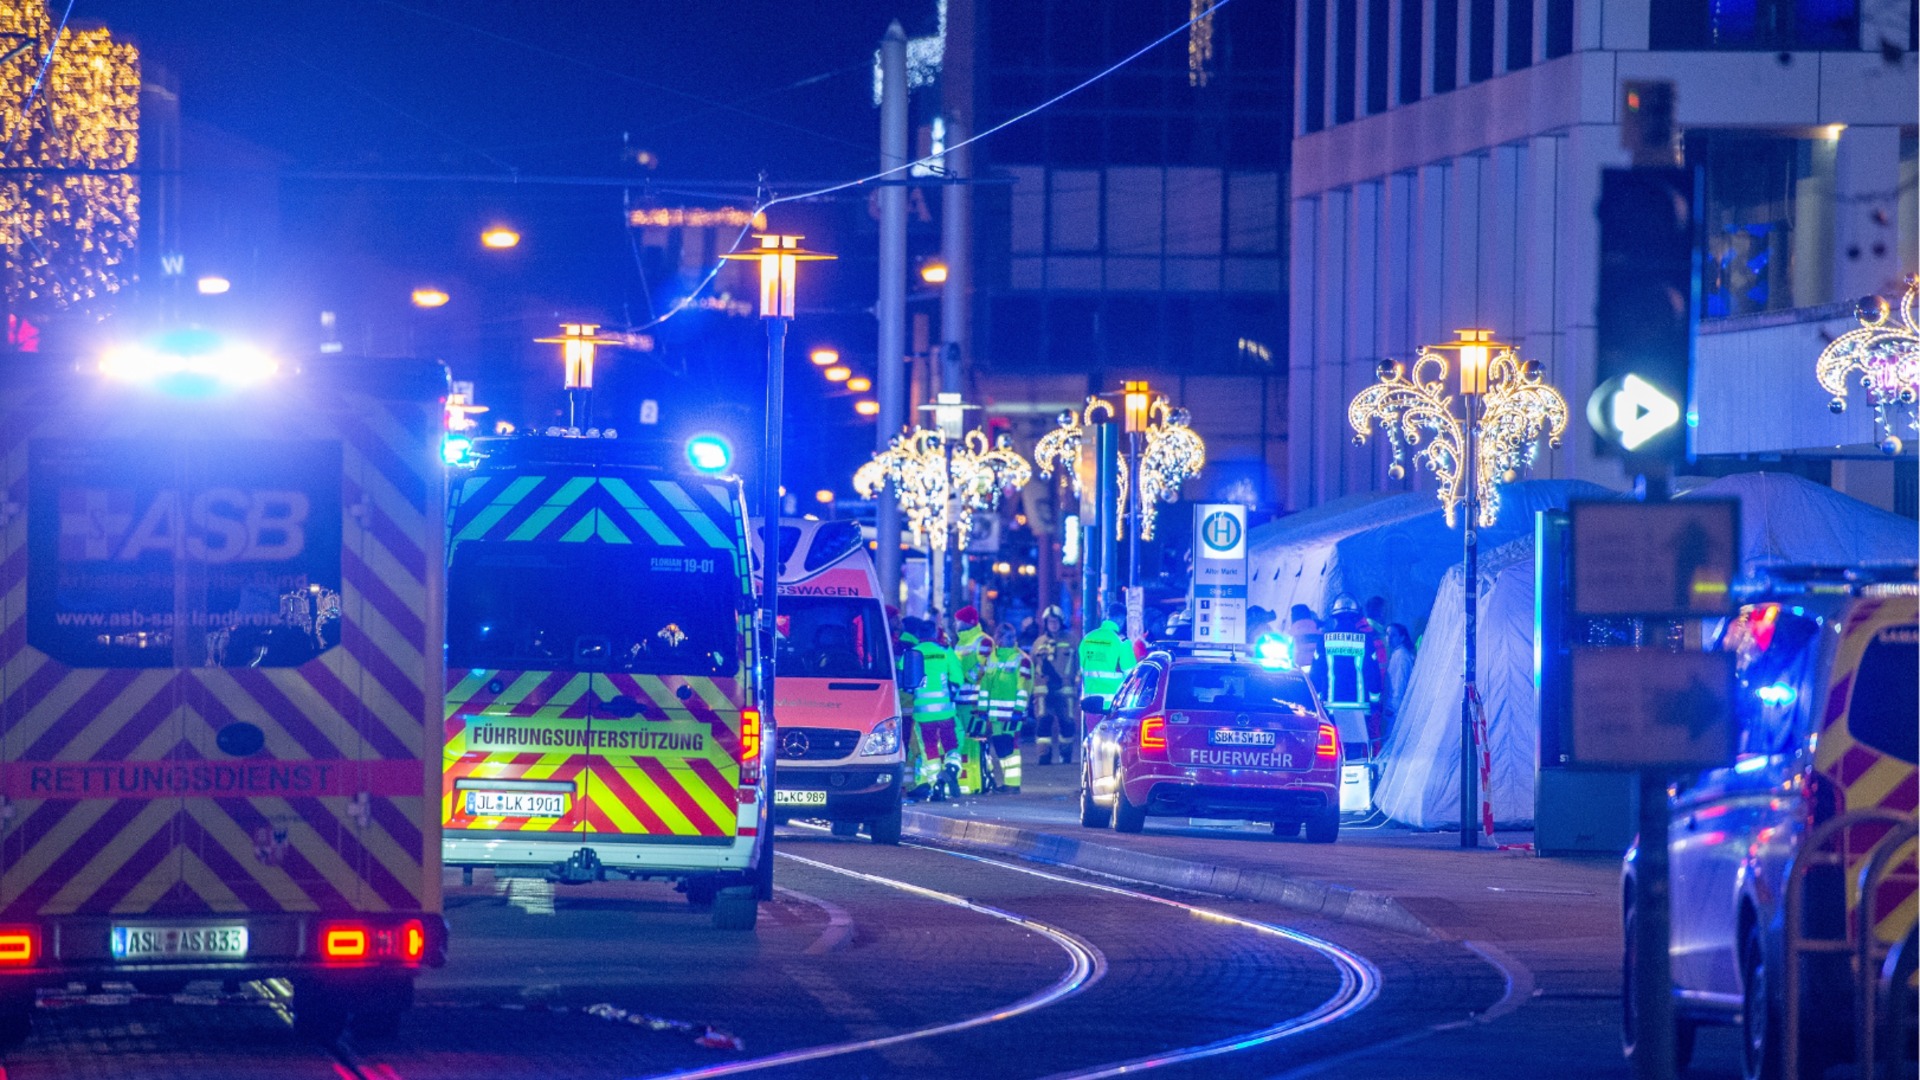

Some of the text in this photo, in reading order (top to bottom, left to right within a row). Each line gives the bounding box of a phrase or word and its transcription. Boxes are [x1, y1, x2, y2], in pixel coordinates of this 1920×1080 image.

[119, 487, 309, 563] ASB
[1214, 519, 1231, 543] H
[683, 558, 715, 574] 19-01
[756, 585, 859, 597] GSWAGEN
[1325, 632, 1365, 641] FEUERWEHR
[472, 723, 703, 751] FÜHRUNGSUNTERSTÜTZUNG
[1215, 731, 1274, 745] SBK SW 112
[1190, 750, 1293, 768] FEUERWEHR
[30, 764, 332, 792] RETTUNGSDIENST
[476, 794, 562, 813] JL LK 1901
[790, 791, 804, 802] KC
[806, 791, 826, 802] 989
[129, 929, 241, 953] ASL AS 833
